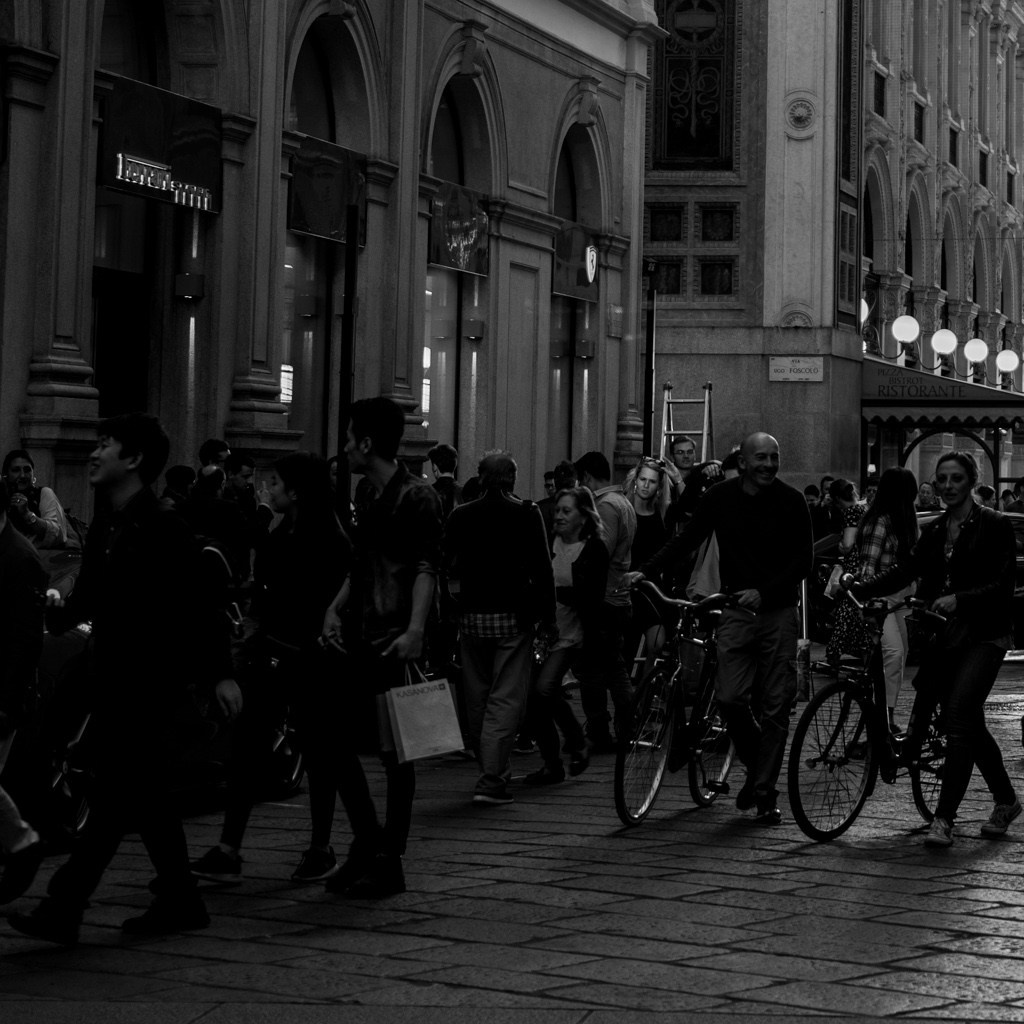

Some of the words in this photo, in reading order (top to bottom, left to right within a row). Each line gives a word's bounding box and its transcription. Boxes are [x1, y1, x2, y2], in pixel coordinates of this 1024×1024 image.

[877, 368, 903, 377] PIZZA
[889, 377, 923, 385] BISTROT
[878, 385, 966, 398] RISTORANTE
